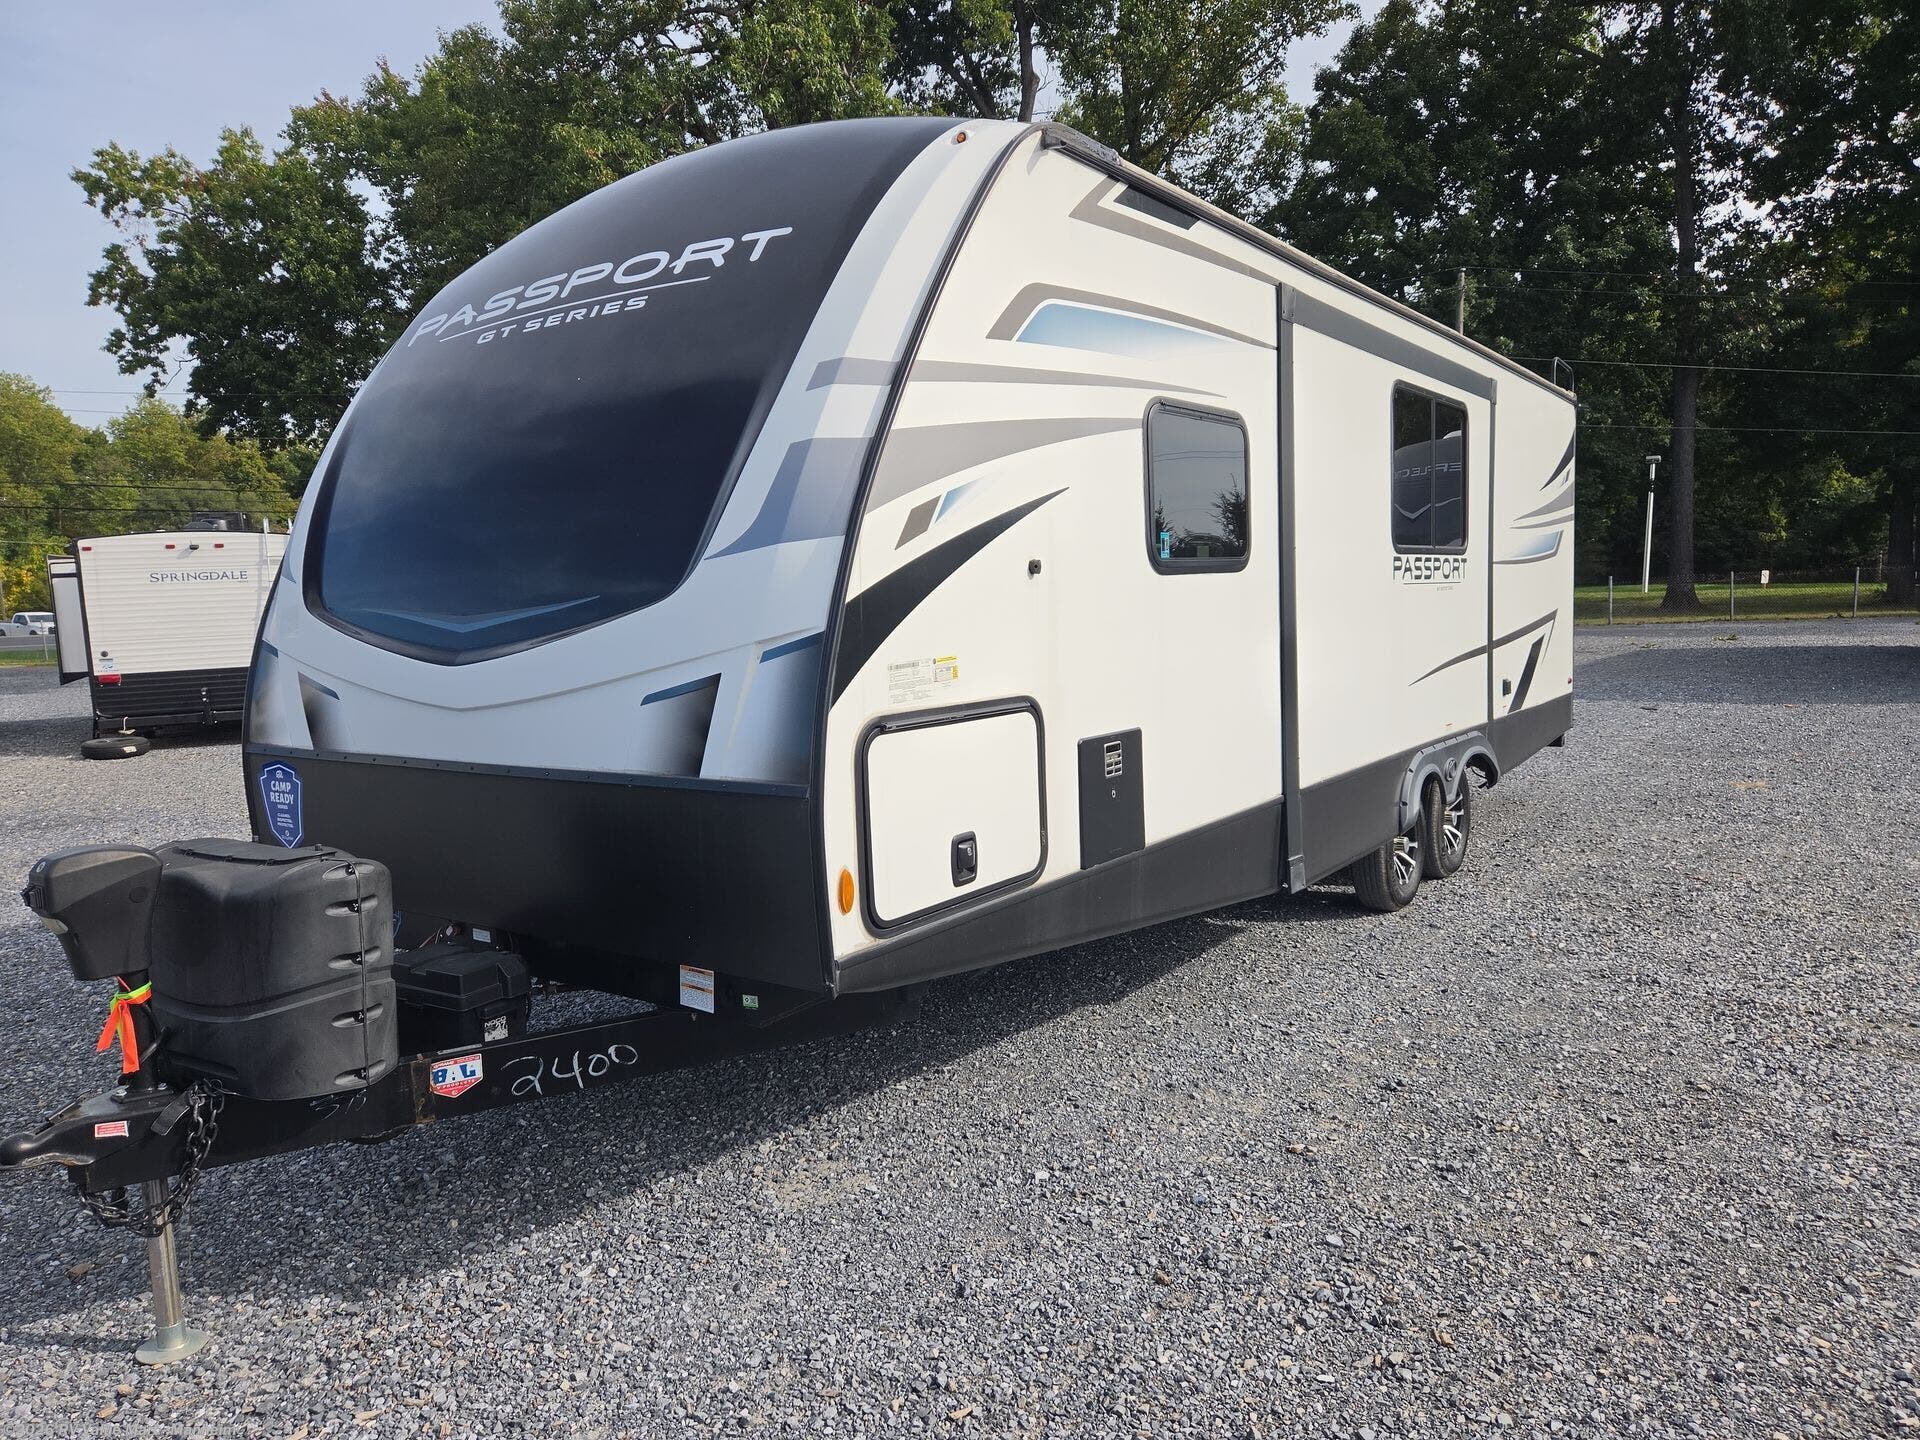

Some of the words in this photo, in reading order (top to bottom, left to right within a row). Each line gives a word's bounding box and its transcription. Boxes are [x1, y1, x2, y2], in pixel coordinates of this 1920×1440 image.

[408, 226, 793, 348] PASSPORT
[476, 324, 517, 345] GT
[524, 295, 649, 330] SERIES
[149, 570, 248, 583] SPRINGDALE
[1393, 556, 1467, 580] PASSPORT
[269, 791, 294, 805] READY
[270, 780, 292, 792] CAMP
[500, 1044, 639, 1096] 2400
